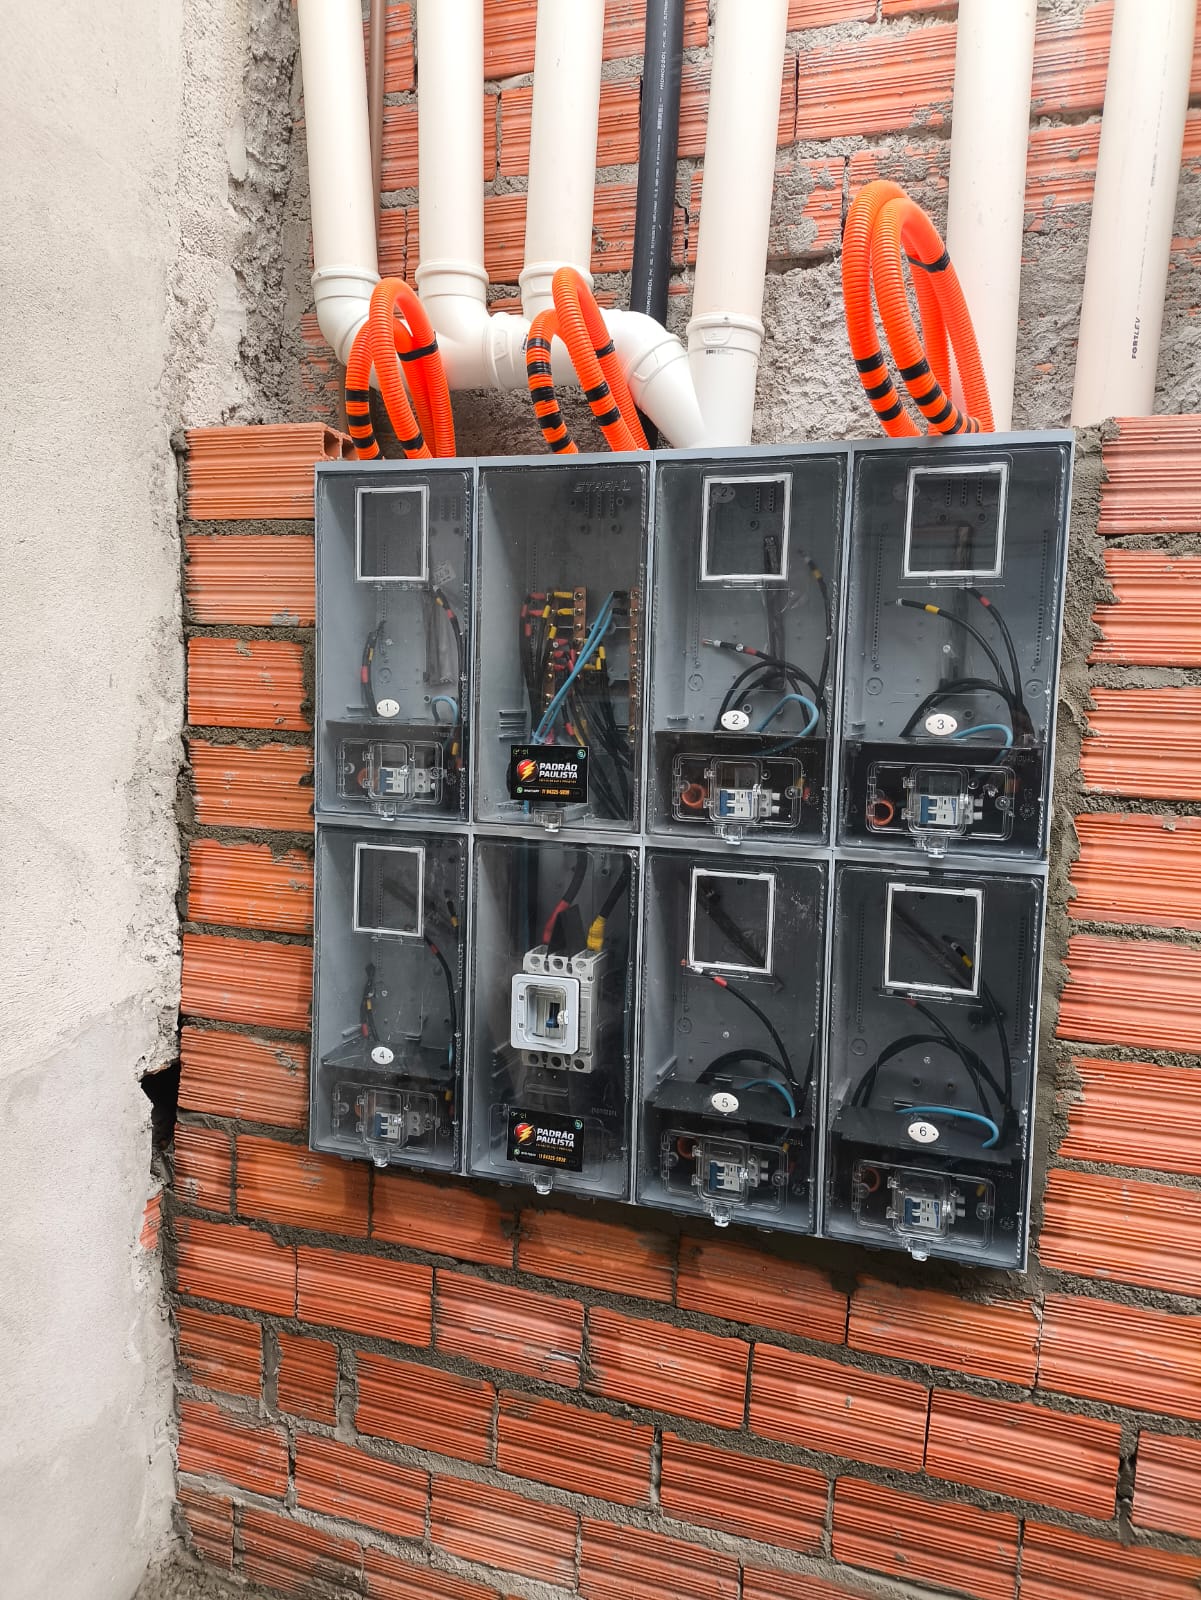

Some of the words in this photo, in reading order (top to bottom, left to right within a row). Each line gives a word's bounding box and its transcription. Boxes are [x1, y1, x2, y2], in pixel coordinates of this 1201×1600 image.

[1131, 316, 1141, 360] FORTLEV
[732, 714, 739, 725] 2
[936, 719, 944, 730] 3
[539, 762, 578, 771] PADRÃO
[539, 771, 578, 779] PAULISTA
[379, 1051, 385, 1060] 4
[721, 1098, 729, 1108] 5
[537, 1127, 575, 1140] PADRÃO
[919, 1126, 927, 1137] 6
[536, 1135, 575, 1148] PAULISTA
